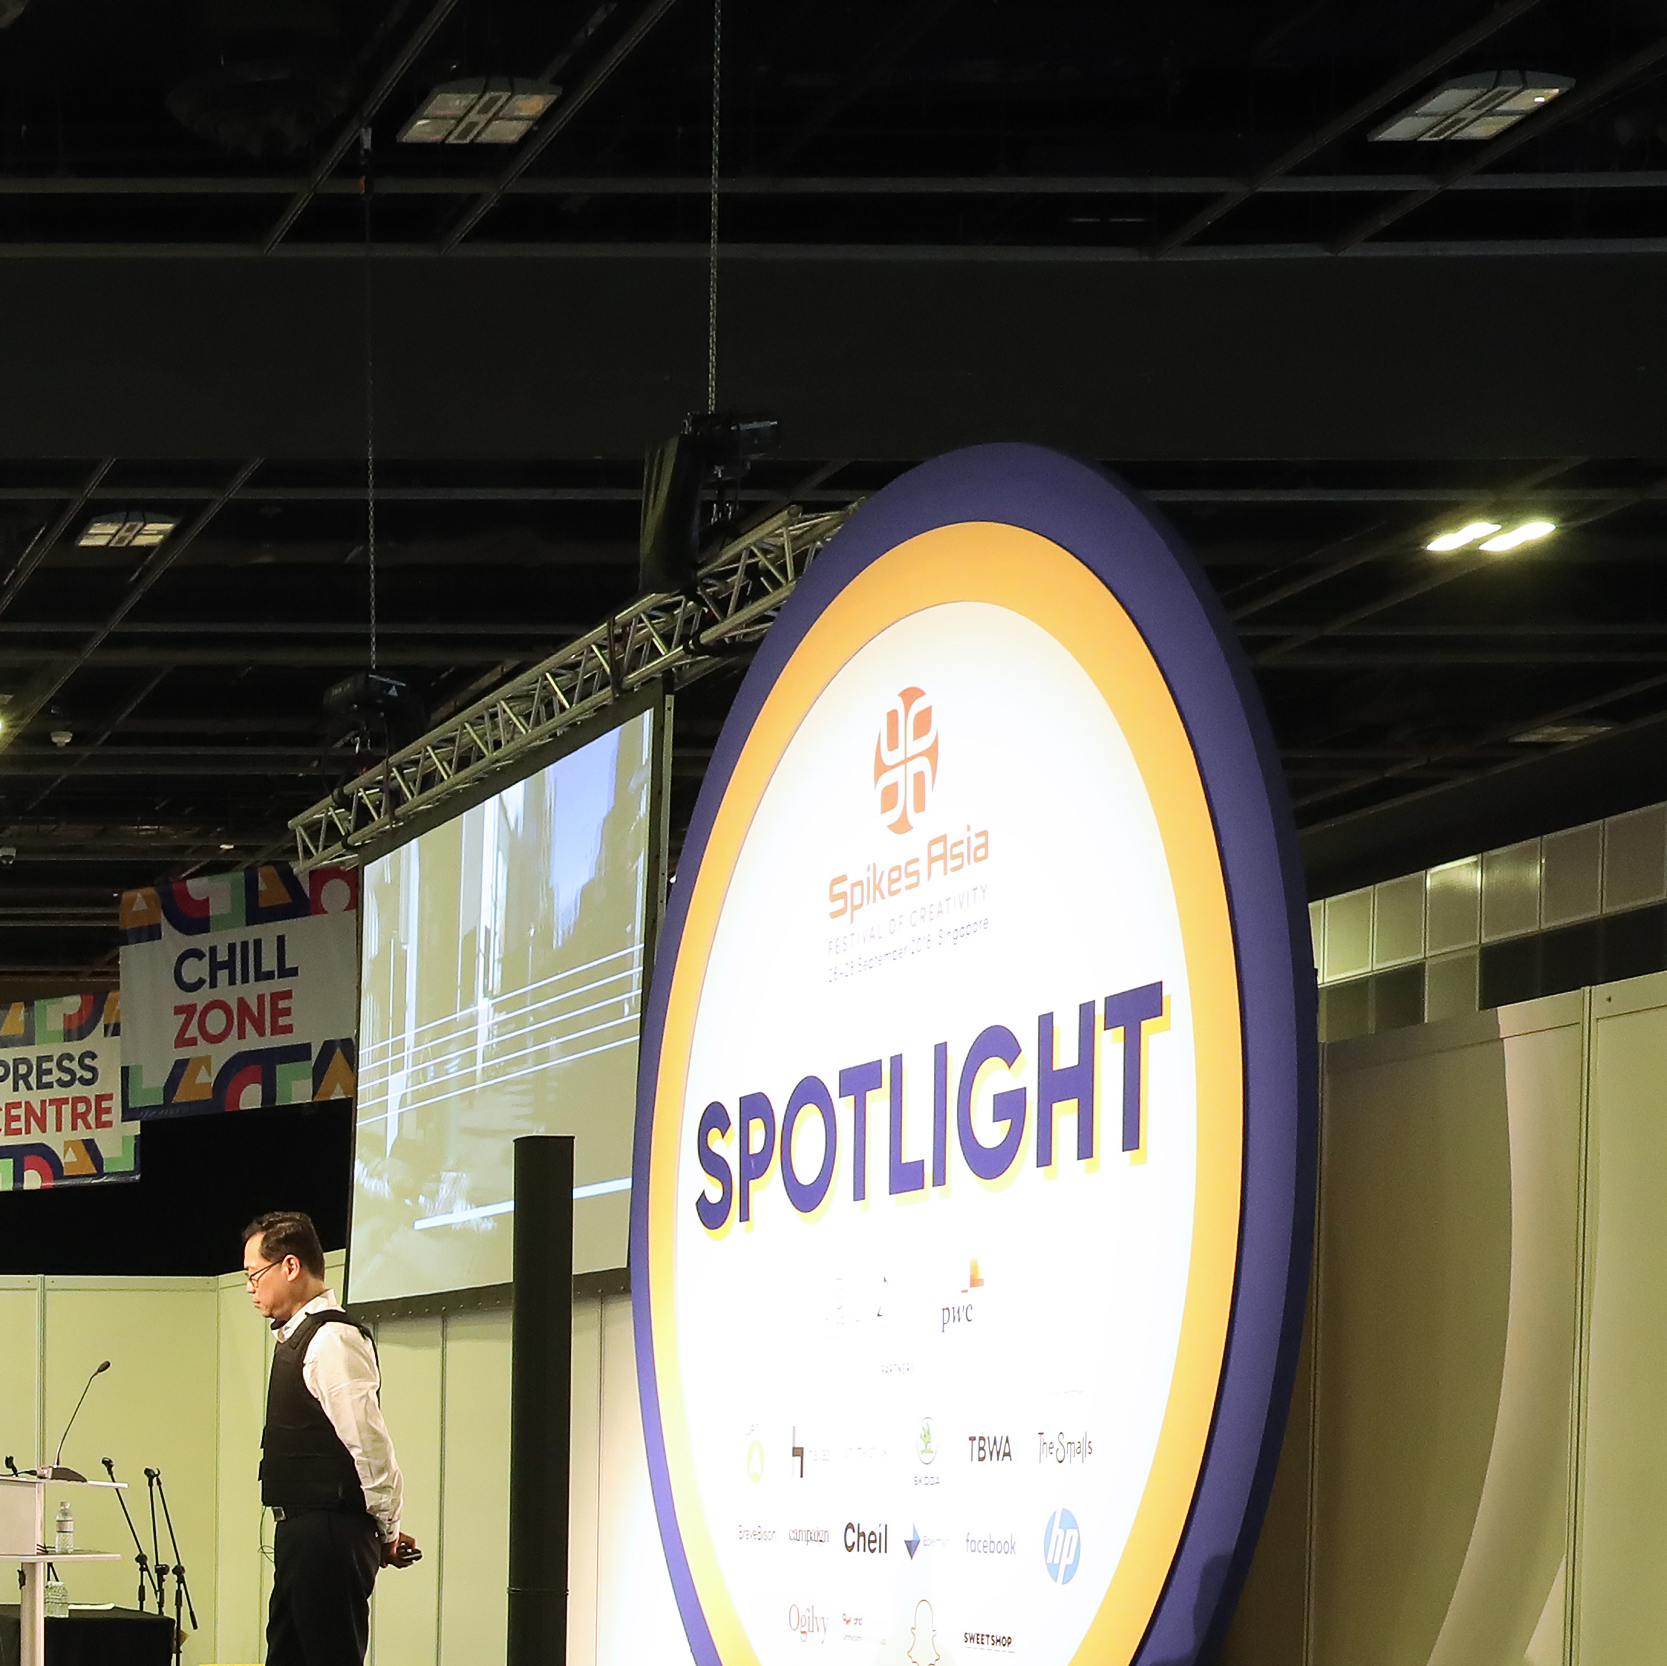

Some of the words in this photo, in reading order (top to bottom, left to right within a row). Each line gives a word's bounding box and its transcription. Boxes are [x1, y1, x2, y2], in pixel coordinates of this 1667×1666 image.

[828, 862, 921, 925] Spikes
[926, 824, 989, 882] Asia
[828, 924, 883, 956] FESTIVAL
[888, 914, 904, 935] OF
[910, 883, 988, 928] CREATIVITY
[937, 917, 989, 946] Singapore
[173, 934, 299, 993] CHILL
[173, 989, 294, 1050] ZONE
[695, 981, 1171, 1237] SPOTLIGHT
[941, 1303, 974, 1333] pwc
[968, 1435, 1012, 1462] TBWA
[843, 1522, 888, 1554] Cheil
[965, 1532, 1017, 1555] facebook
[1044, 1507, 1081, 1585] hp
[788, 1603, 829, 1644] Ogilvy
[963, 1631, 1013, 1648] SWEETSHOP
